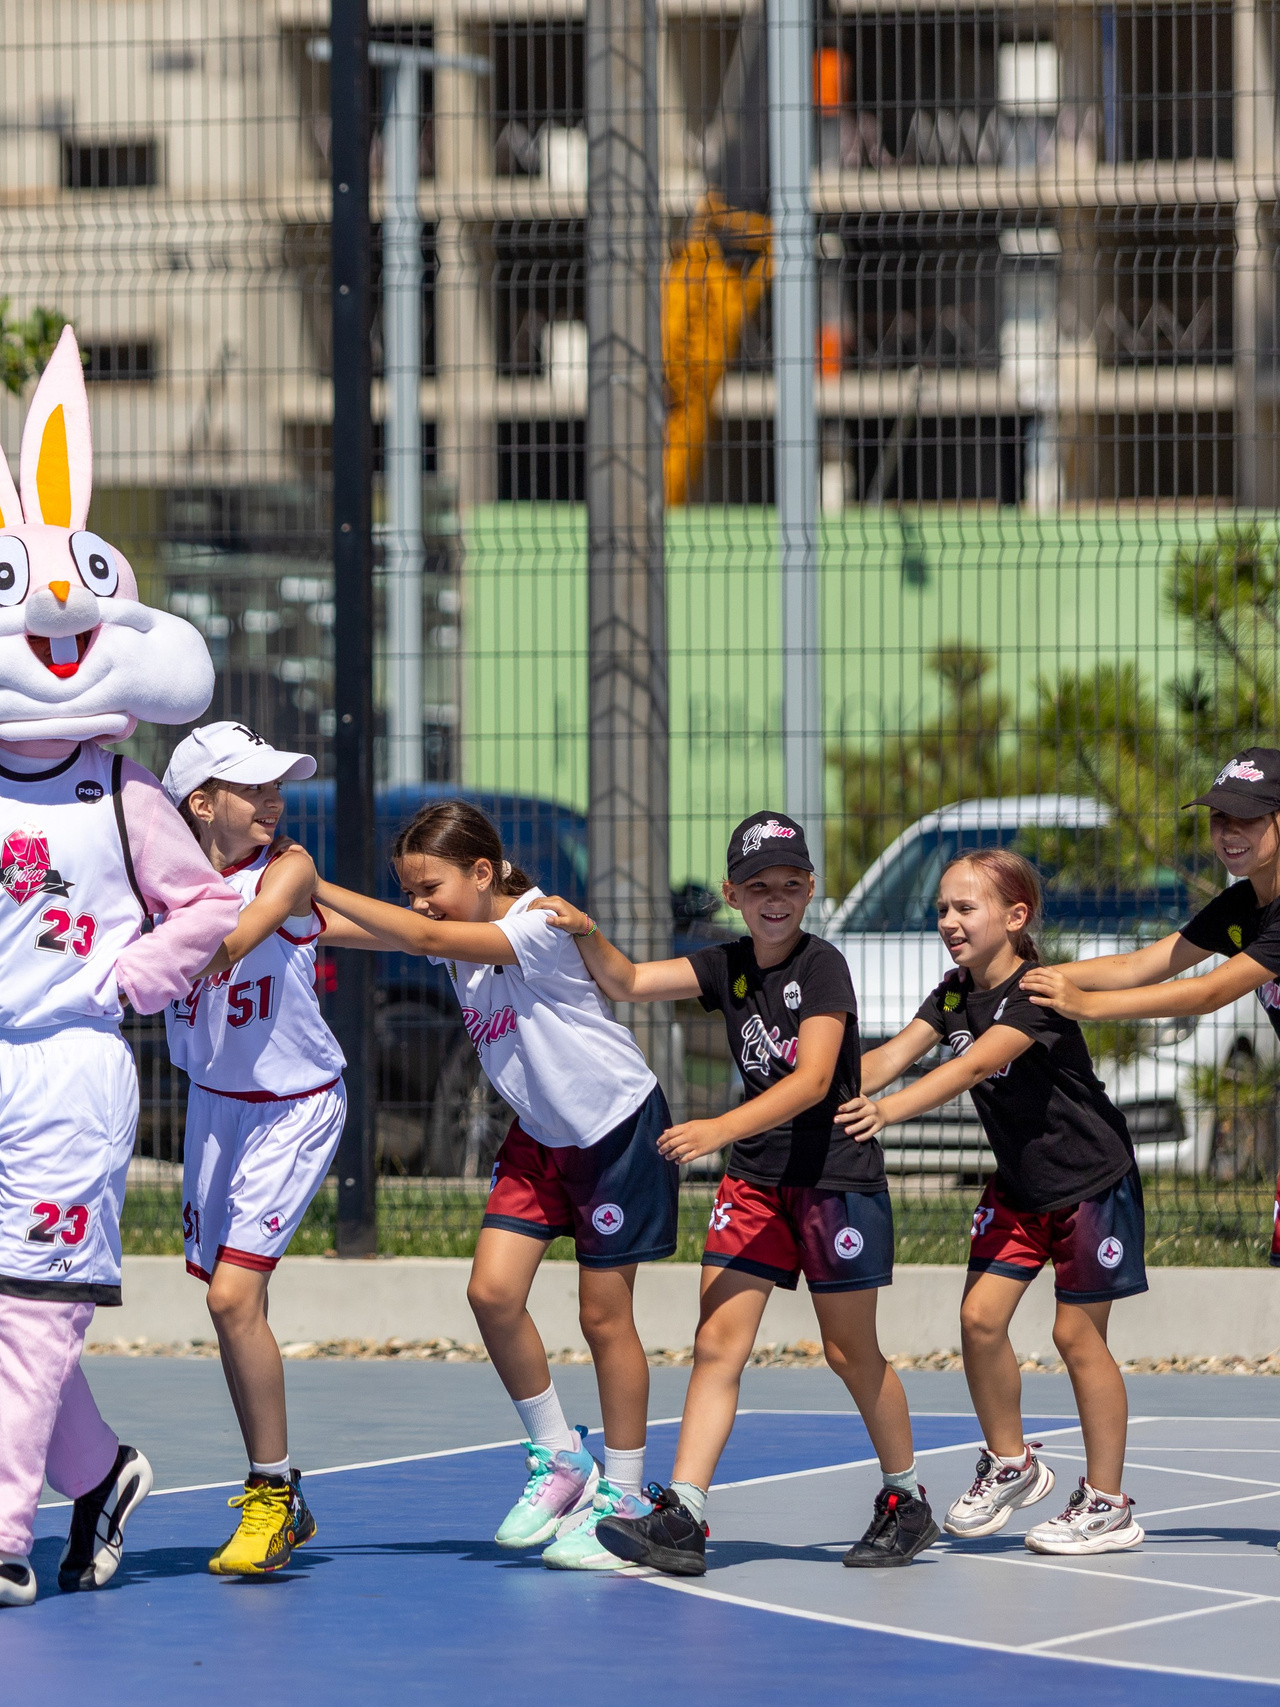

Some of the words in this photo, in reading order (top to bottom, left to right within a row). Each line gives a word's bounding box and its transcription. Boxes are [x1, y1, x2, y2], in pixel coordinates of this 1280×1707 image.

[78, 787, 102, 797] РФБ
[741, 819, 797, 856] Рубин
[2, 862, 48, 889] Рубин
[34, 905, 99, 960] 23
[227, 974, 276, 1030] 51
[25, 1198, 92, 1248] 23
